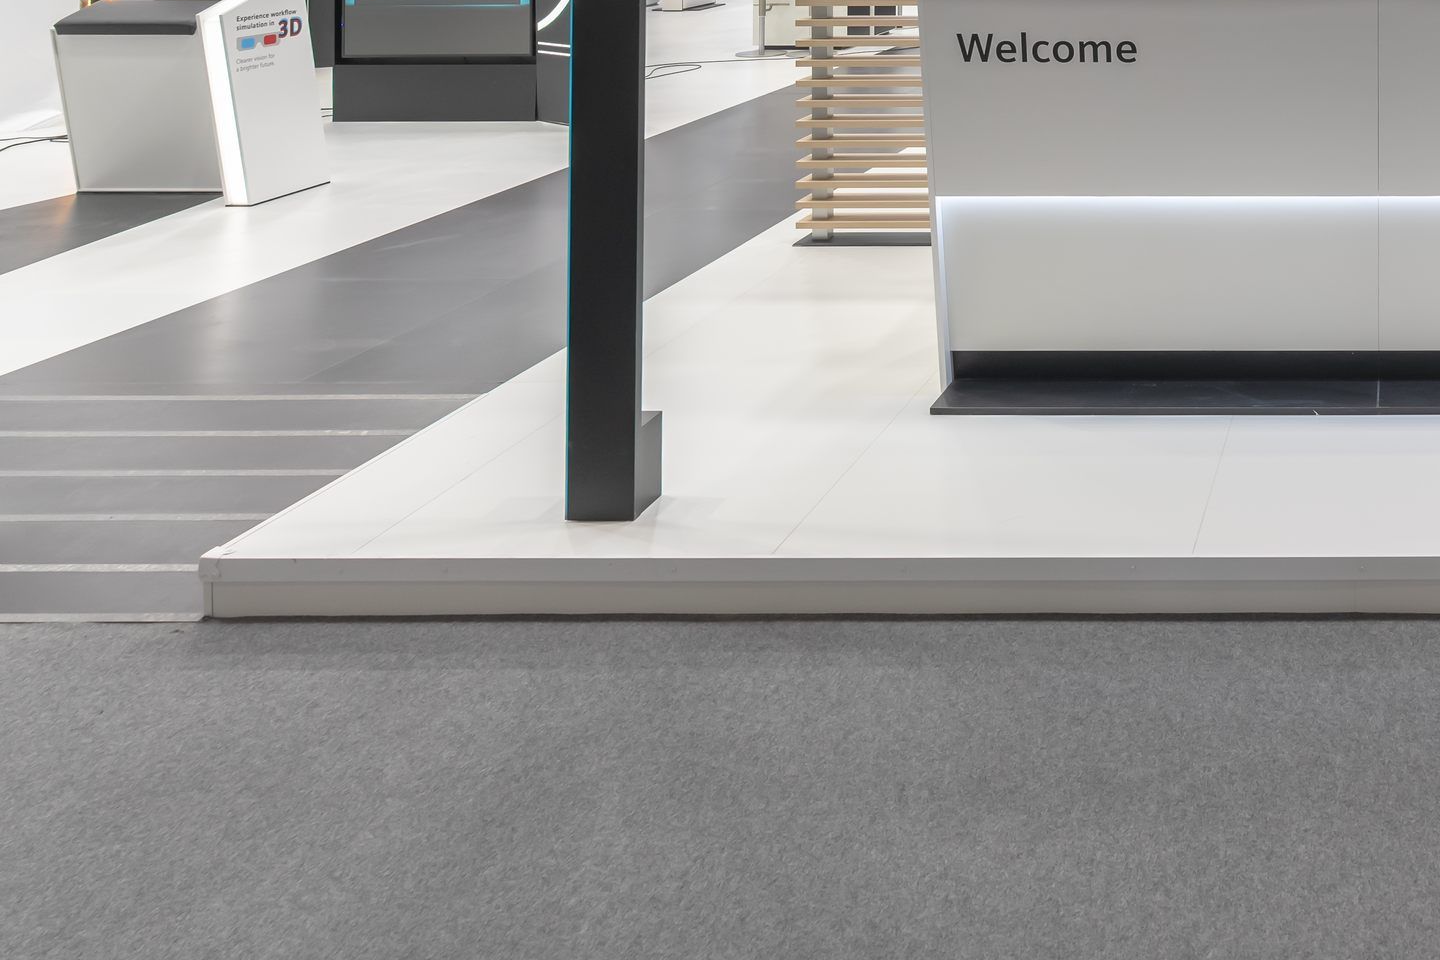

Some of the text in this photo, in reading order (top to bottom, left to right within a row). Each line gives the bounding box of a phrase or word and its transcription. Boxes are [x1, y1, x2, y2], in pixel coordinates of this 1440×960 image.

[236, 8, 297, 23] Experience workflow
[236, 21, 268, 31] simulation
[278, 15, 303, 38] 3D
[956, 31, 1138, 65] Welcome
